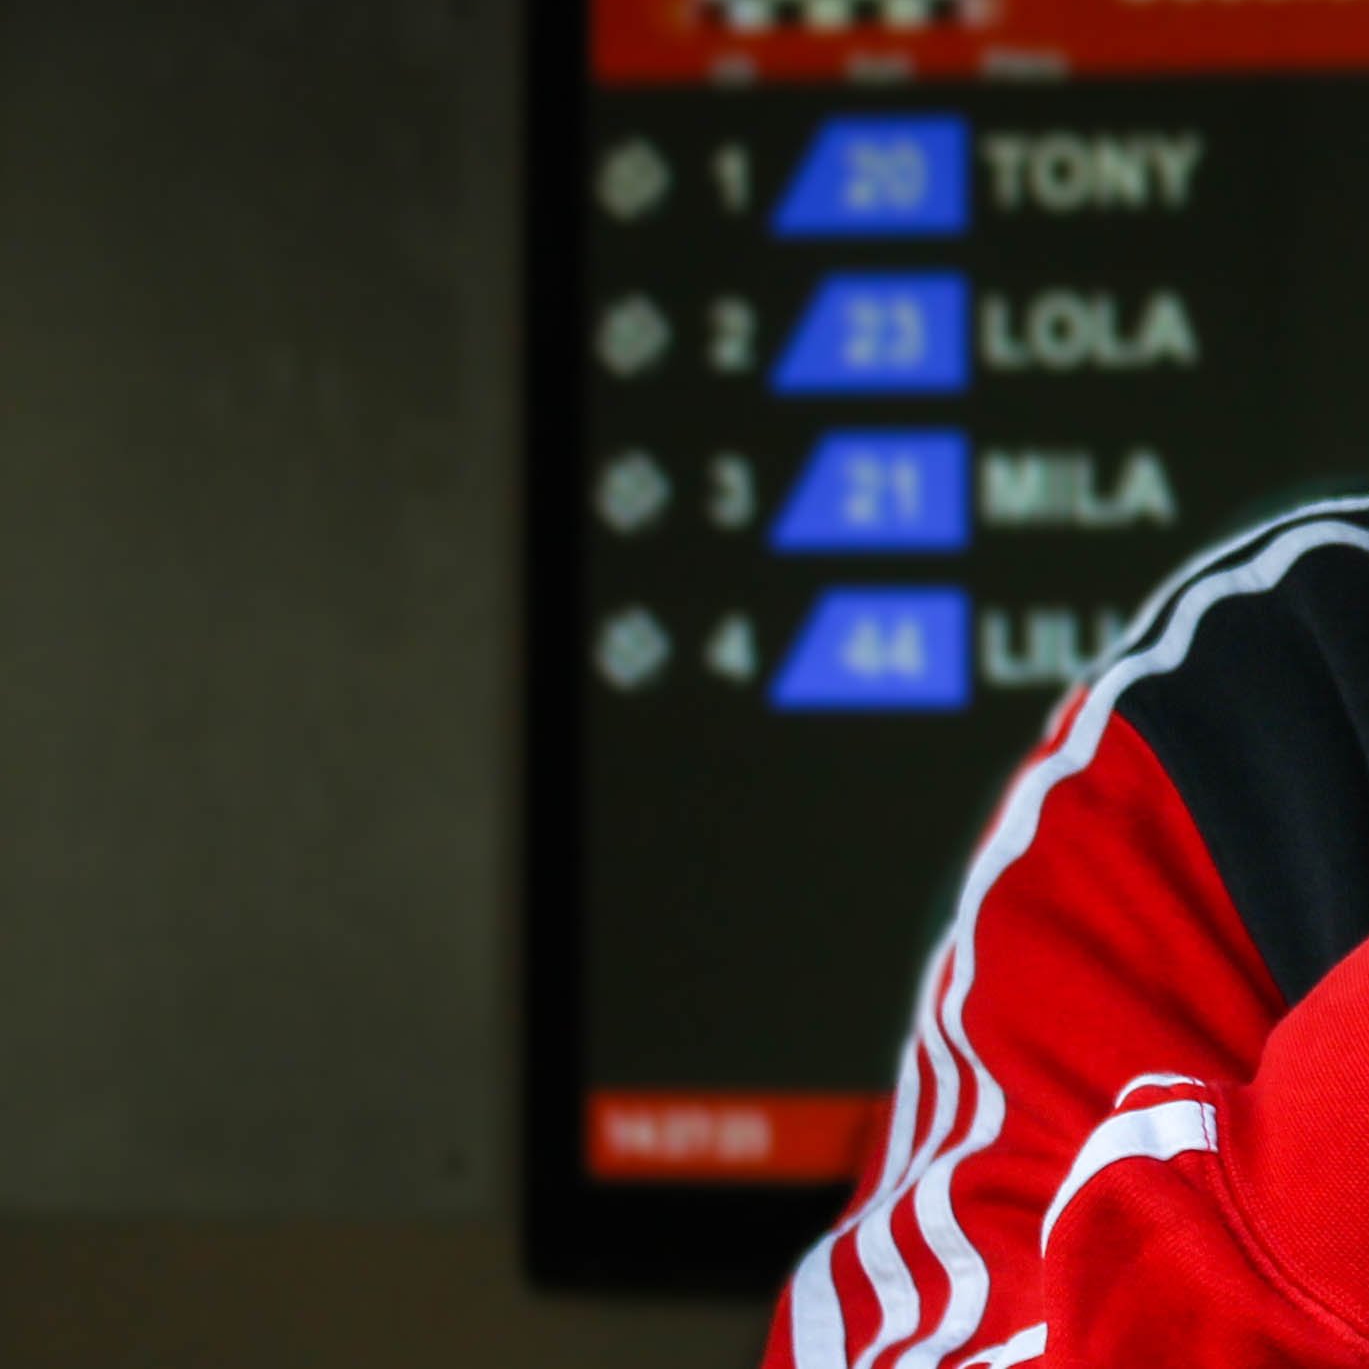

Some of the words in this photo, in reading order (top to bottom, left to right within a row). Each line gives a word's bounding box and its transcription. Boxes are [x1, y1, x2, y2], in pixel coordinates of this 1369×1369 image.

[711, 140, 752, 214] 1
[843, 142, 930, 212] 20
[980, 134, 1203, 212] TONY
[708, 294, 757, 371] 2
[841, 297, 928, 368] 23
[980, 292, 1197, 369] LOLA
[708, 450, 757, 528] 3
[841, 450, 923, 524] 21
[980, 450, 1176, 526] MILA
[704, 610, 758, 684] 4
[841, 608, 929, 679] 44
